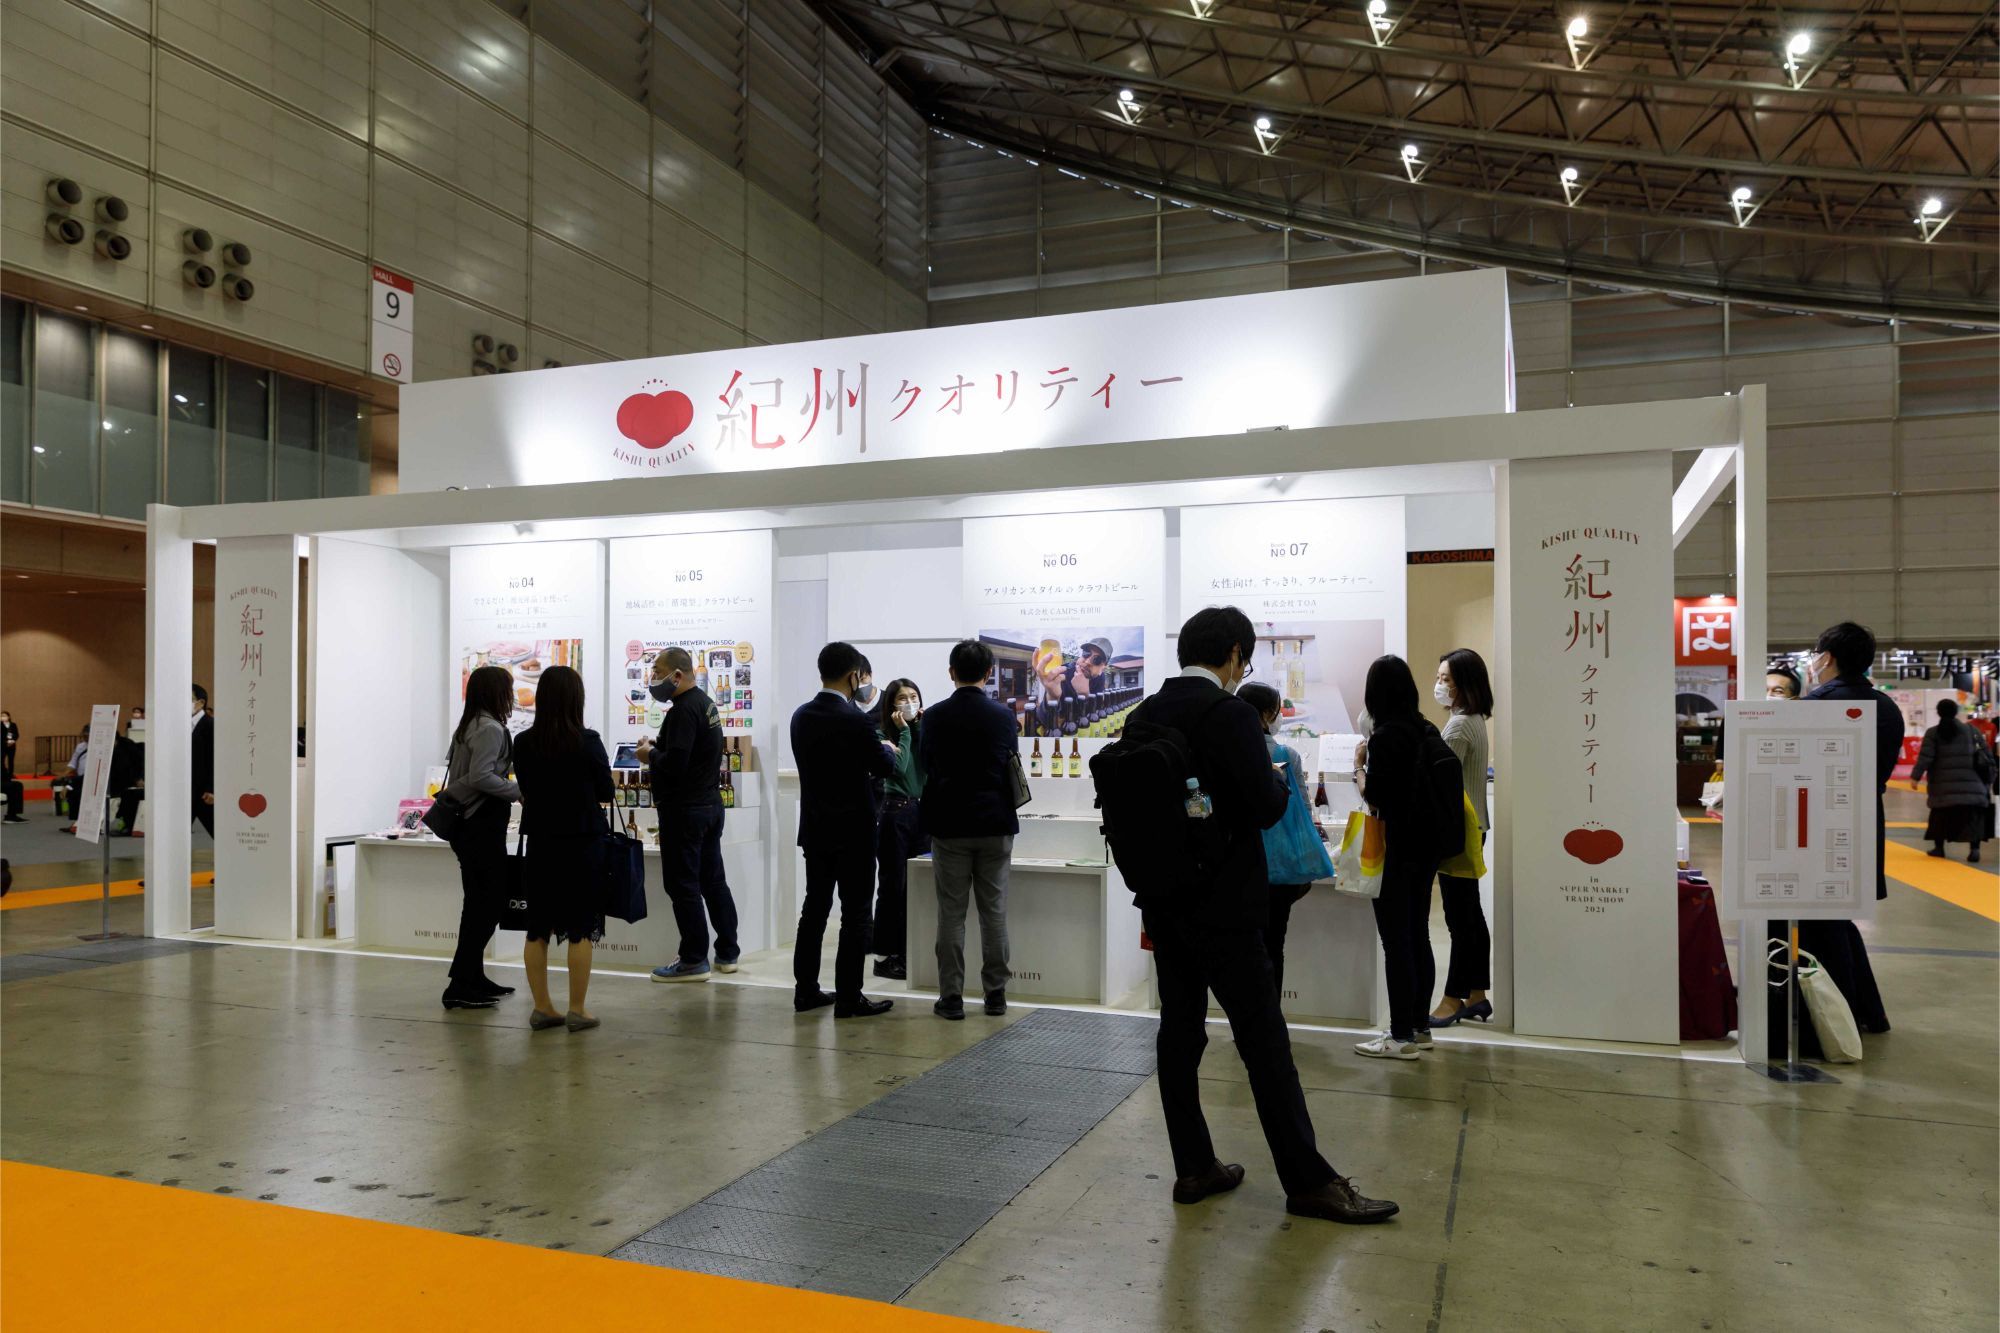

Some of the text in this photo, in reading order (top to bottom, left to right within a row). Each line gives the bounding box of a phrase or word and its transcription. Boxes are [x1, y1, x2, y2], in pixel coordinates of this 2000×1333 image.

[374, 269, 394, 284] HALL
[385, 291, 400, 319] 9
[713, 361, 1184, 454] 紀州クオリティー
[613, 441, 695, 468] KISHU QUALITY
[1541, 527, 1640, 549] KISHU QUALITY
[1289, 542, 1309, 556] 07
[1060, 553, 1077, 566] 06
[1411, 549, 1494, 564] KAGOSHIMA
[689, 569, 703, 581] 05
[521, 577, 534, 588] 04
[250, 586, 279, 600] QUALITY
[1563, 552, 1612, 804] 紀州クオリティー
[240, 603, 264, 777] 紀州クオリティー
[1589, 875, 1599, 883] in
[1559, 885, 1631, 894] SUPER MARKET
[1564, 895, 1596, 903] TRADE
[1584, 905, 1605, 913] 2021
[414, 929, 458, 939] KISHU QUALITY
[610, 943, 639, 952] QUALITY
